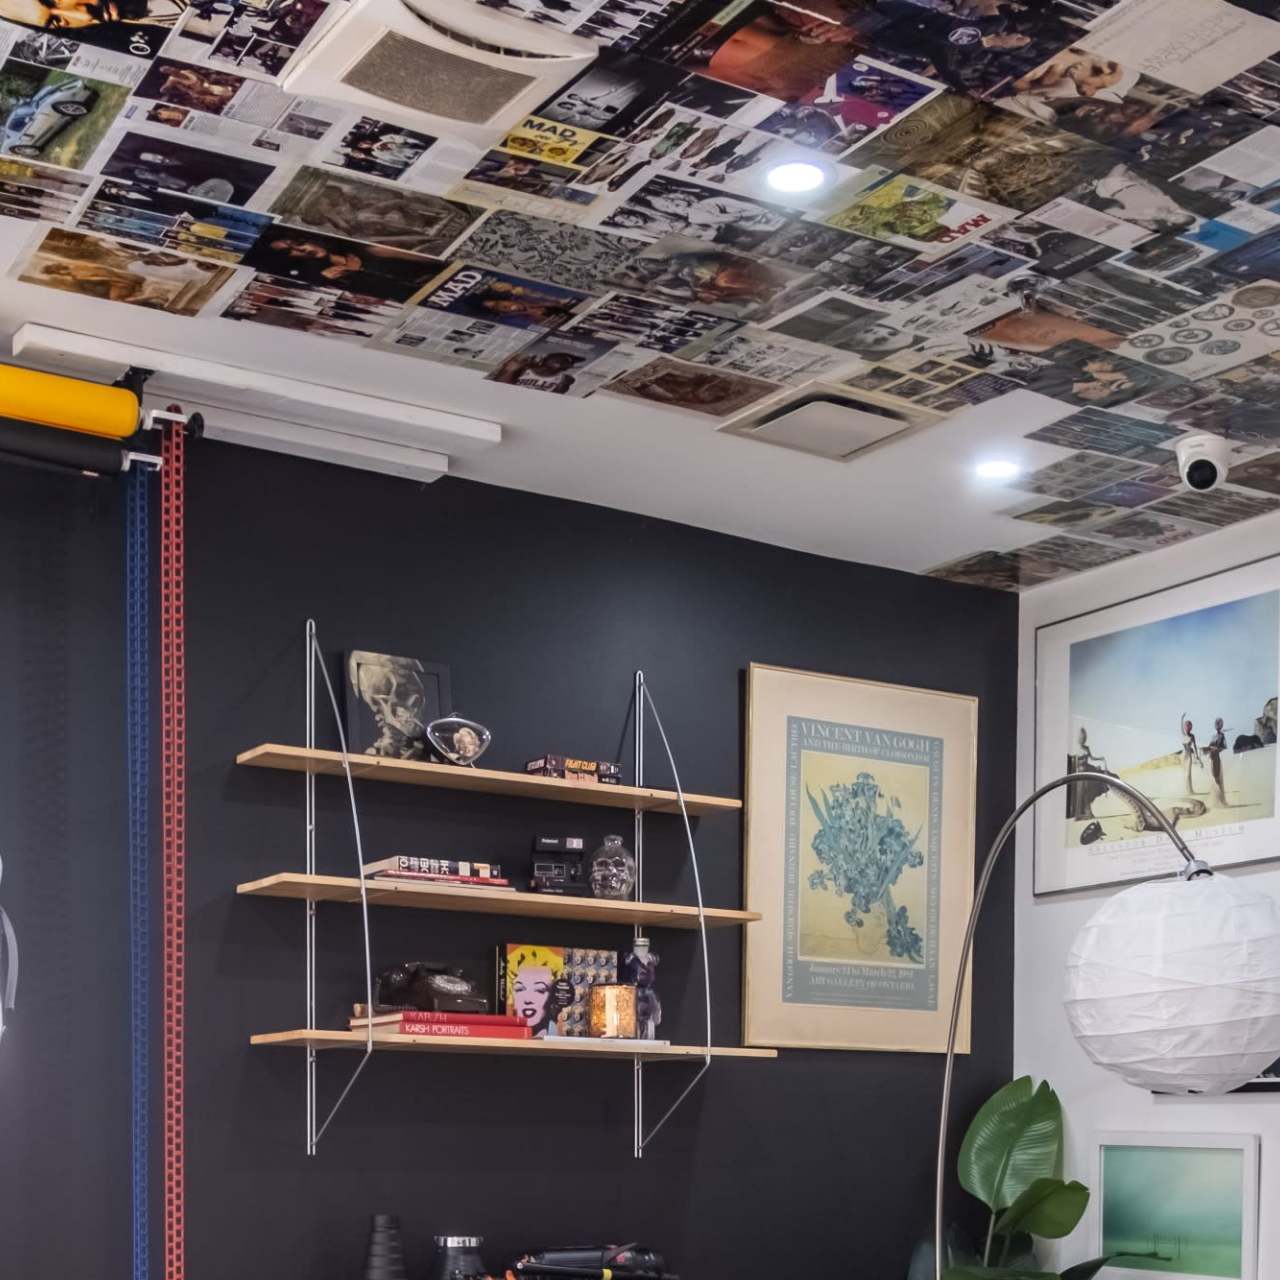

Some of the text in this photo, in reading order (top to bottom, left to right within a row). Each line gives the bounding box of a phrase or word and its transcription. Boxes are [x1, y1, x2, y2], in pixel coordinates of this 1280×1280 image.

[523, 119, 576, 138] MAD
[431, 271, 482, 307] MAD
[801, 721, 930, 752] VINCENT VAN GOGH
[405, 1023, 470, 1036] KARSH PORTRAITS
